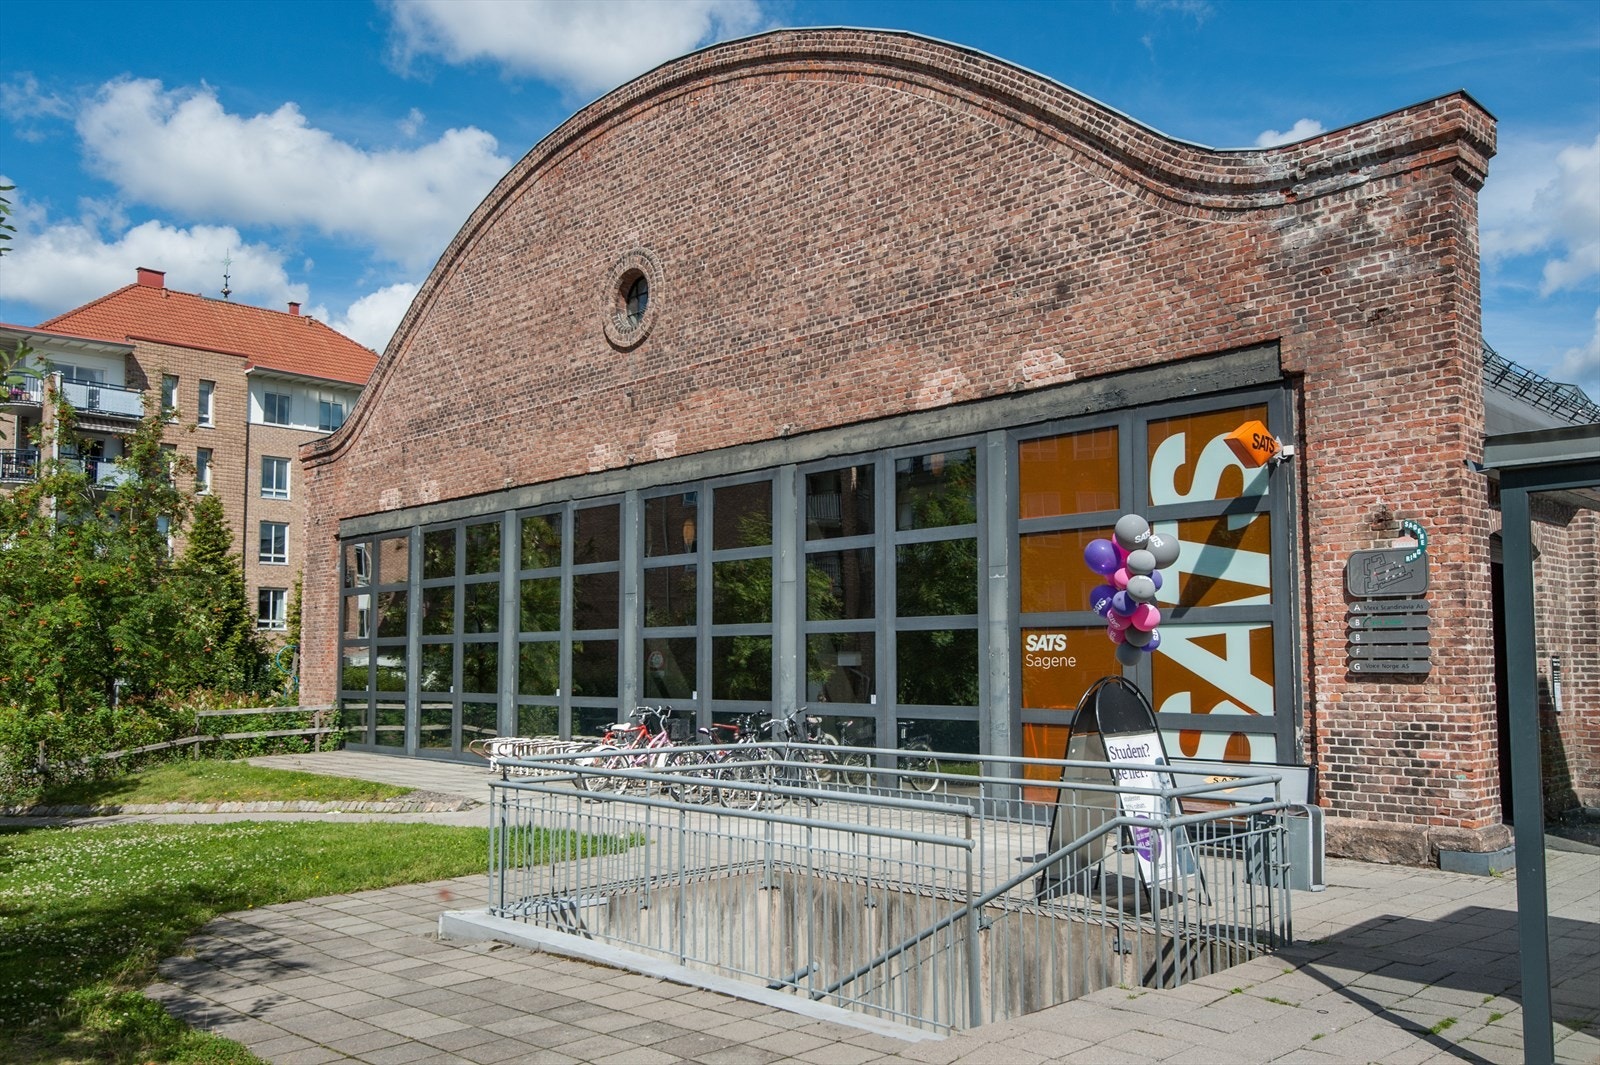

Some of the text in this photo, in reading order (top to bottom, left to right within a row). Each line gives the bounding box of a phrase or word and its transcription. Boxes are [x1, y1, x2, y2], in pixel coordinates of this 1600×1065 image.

[1252, 433, 1275, 453] SATS
[1134, 529, 1151, 543] SATS
[1149, 535, 1164, 548] ATS
[1404, 521, 1425, 562] SAGENE RING
[1150, 432, 1276, 763] SATS
[1380, 603, 1414, 611] Scandinavia
[1025, 633, 1067, 652] SATS
[1025, 653, 1077, 670] Sagene
[1108, 743, 1151, 760] Student?
